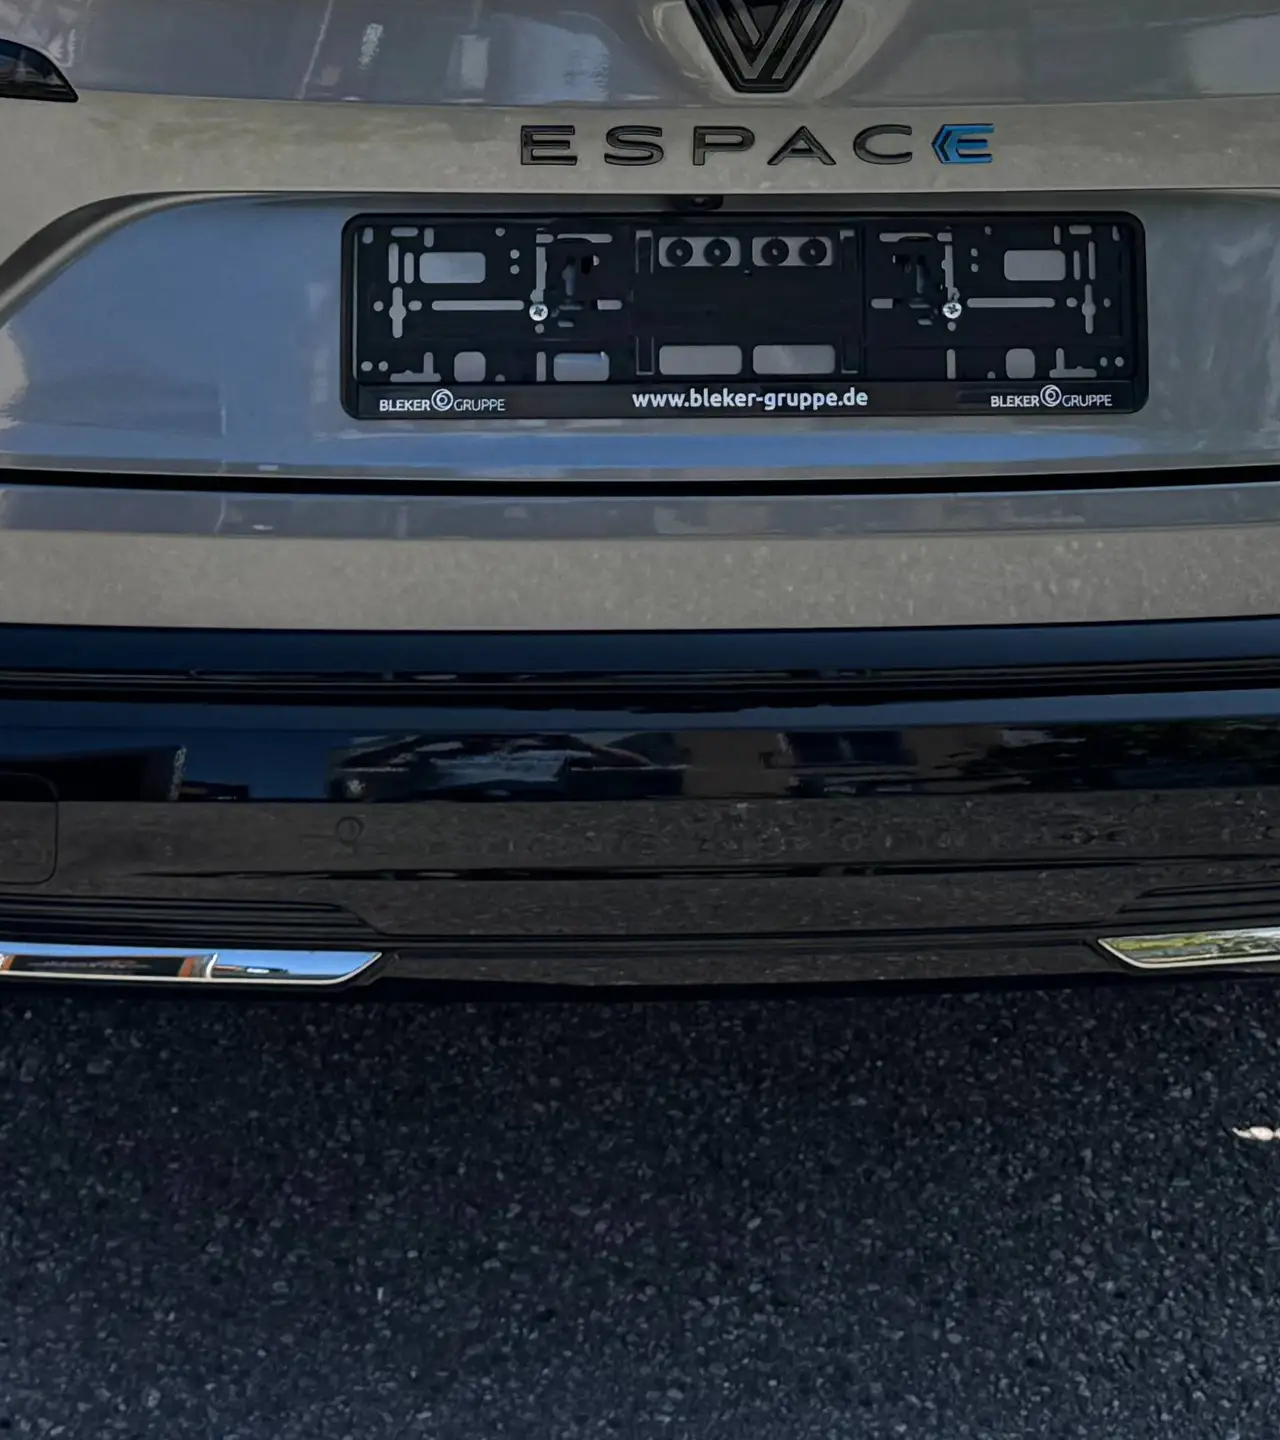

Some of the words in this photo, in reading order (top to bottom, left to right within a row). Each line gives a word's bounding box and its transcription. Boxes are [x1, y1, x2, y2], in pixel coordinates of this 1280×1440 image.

[520, 124, 995, 166] ESPACE
[379, 398, 431, 412] BLEKER
[453, 398, 506, 412] GRUPPE
[631, 386, 869, 411] www.bleker-gruppe.de
[990, 395, 1040, 408] BLEKER
[1061, 394, 1113, 407] GRUPPE
